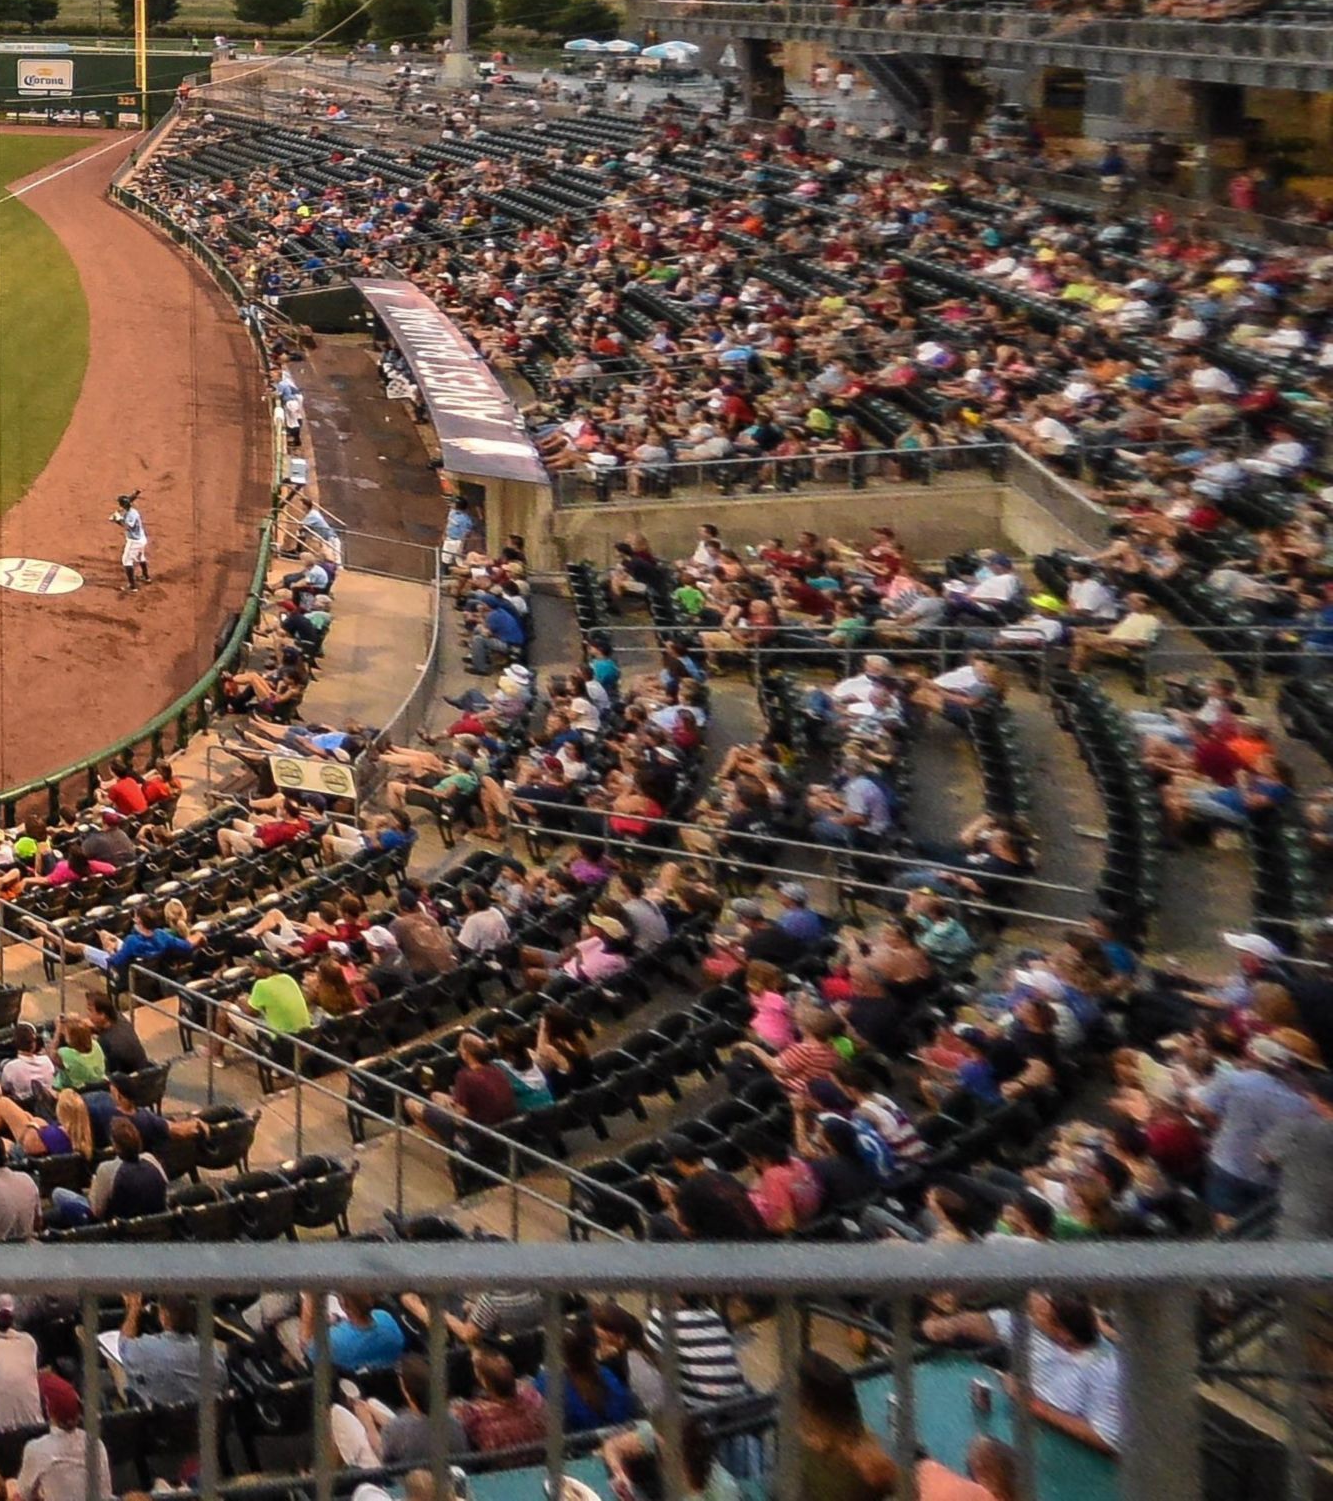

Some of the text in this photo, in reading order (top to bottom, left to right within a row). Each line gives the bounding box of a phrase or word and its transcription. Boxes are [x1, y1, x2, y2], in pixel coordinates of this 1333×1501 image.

[24, 75, 65, 86] Corona
[385, 305, 512, 426] ARVEST BALLPARK
